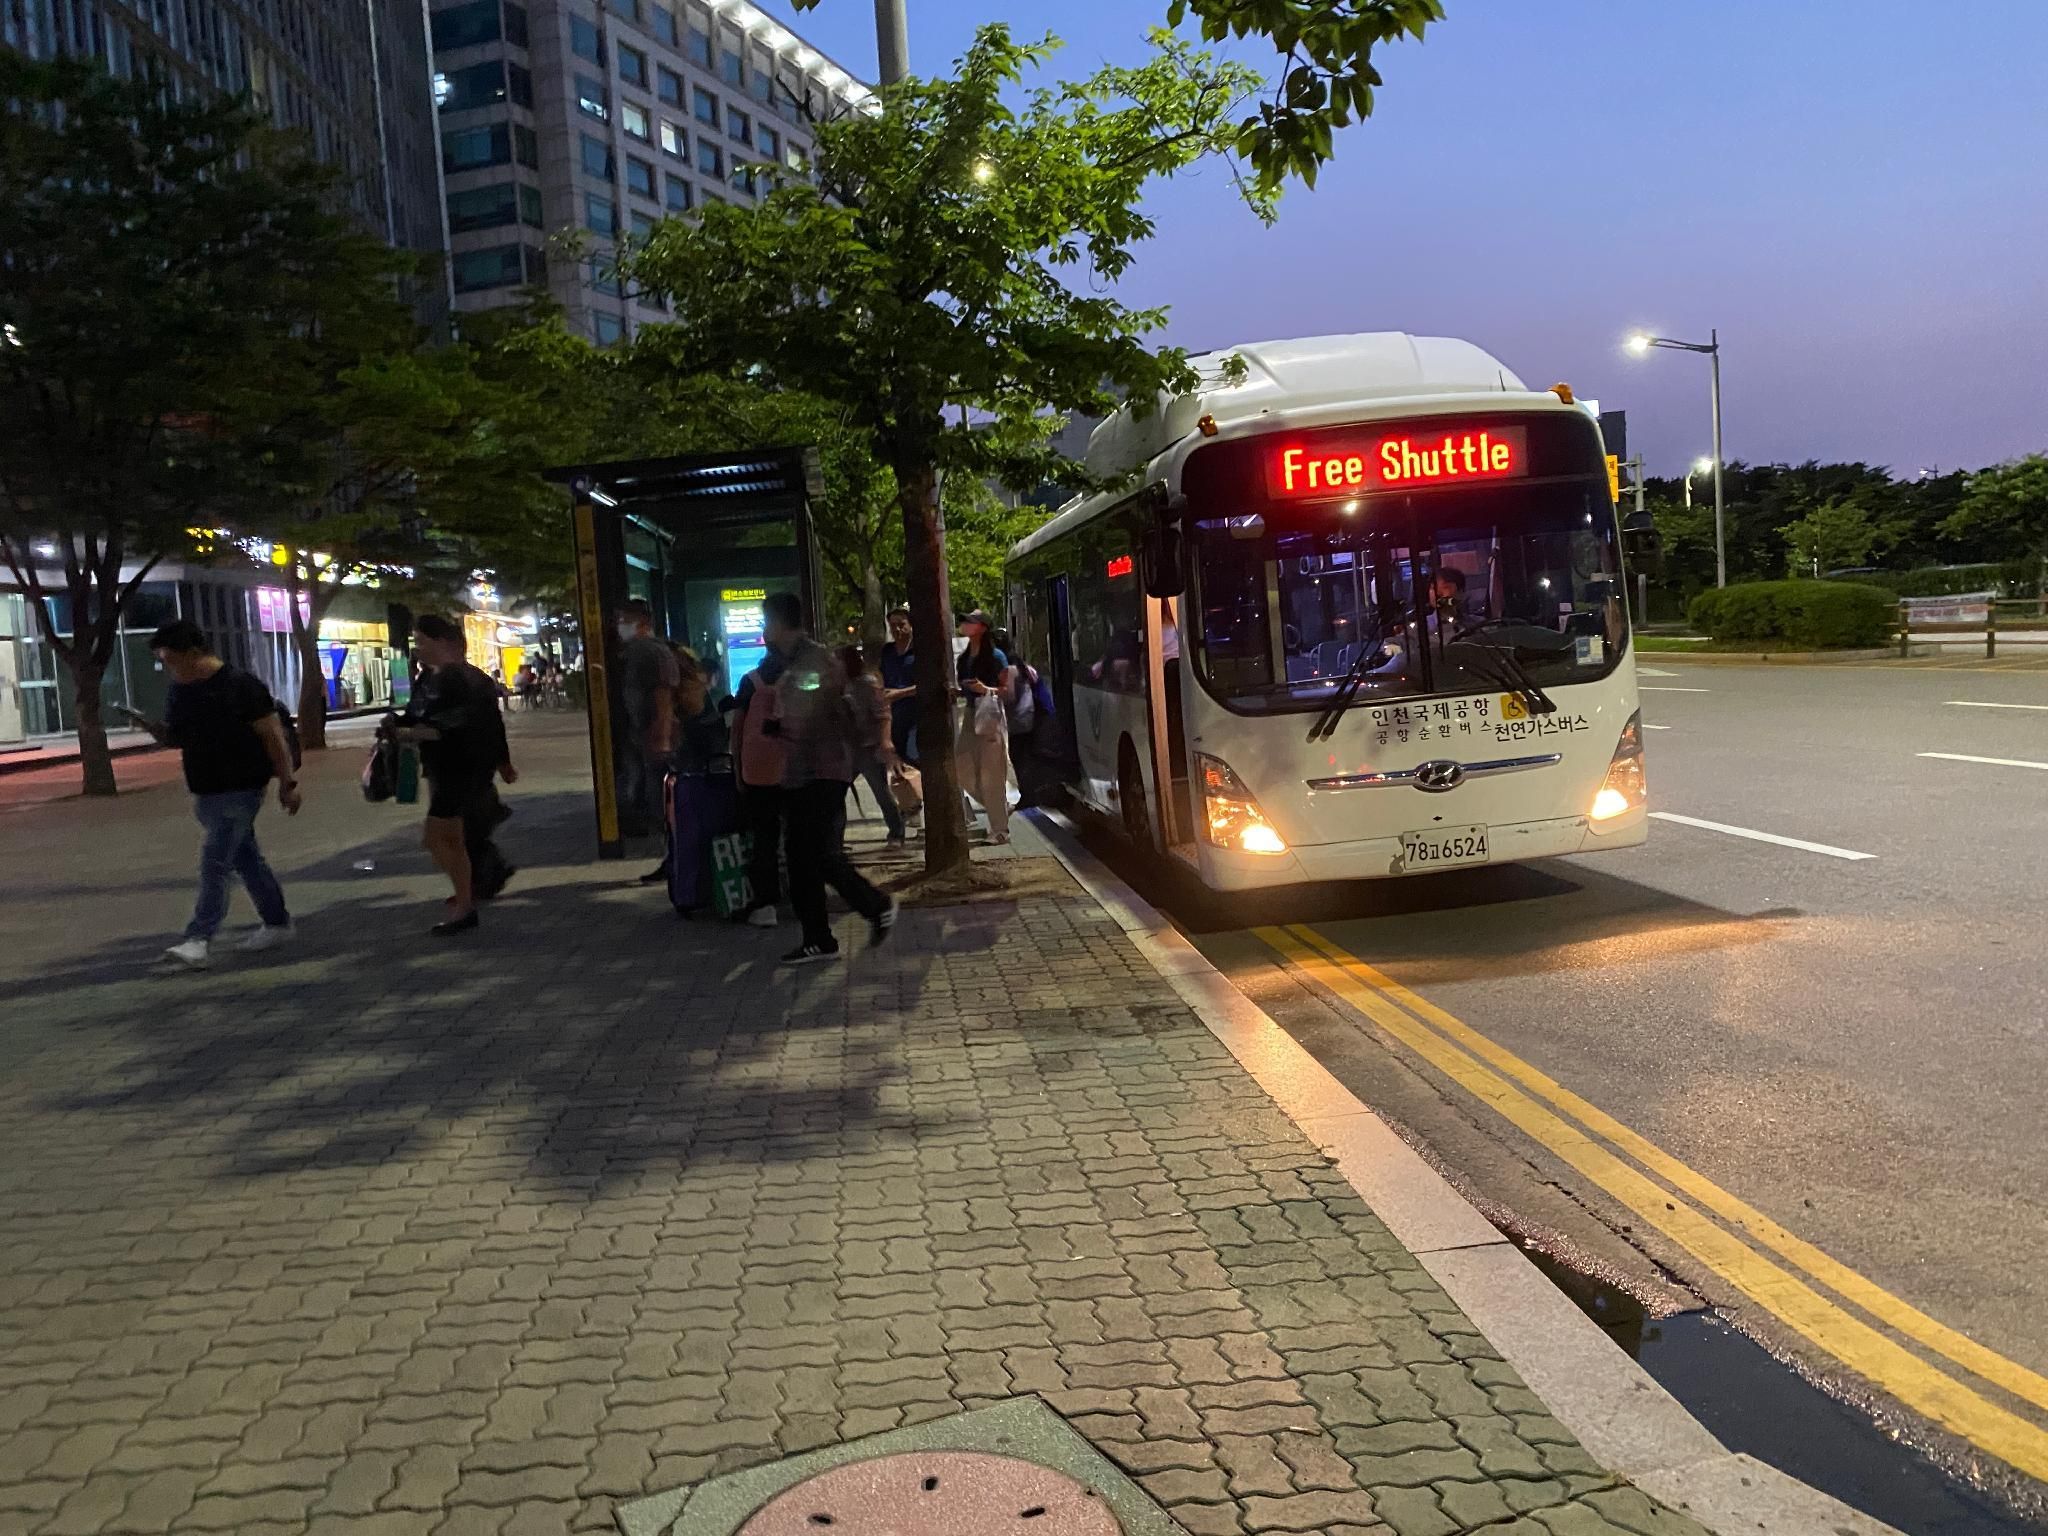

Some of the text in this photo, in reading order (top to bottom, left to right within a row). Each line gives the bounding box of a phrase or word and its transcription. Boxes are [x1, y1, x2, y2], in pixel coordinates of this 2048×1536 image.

[1283, 433, 1510, 490] Free Shuttle
[1371, 698, 1490, 727] 인천국제공항
[1495, 714, 1589, 742] 천연가스버스
[1405, 835, 1487, 862] 78고6524
